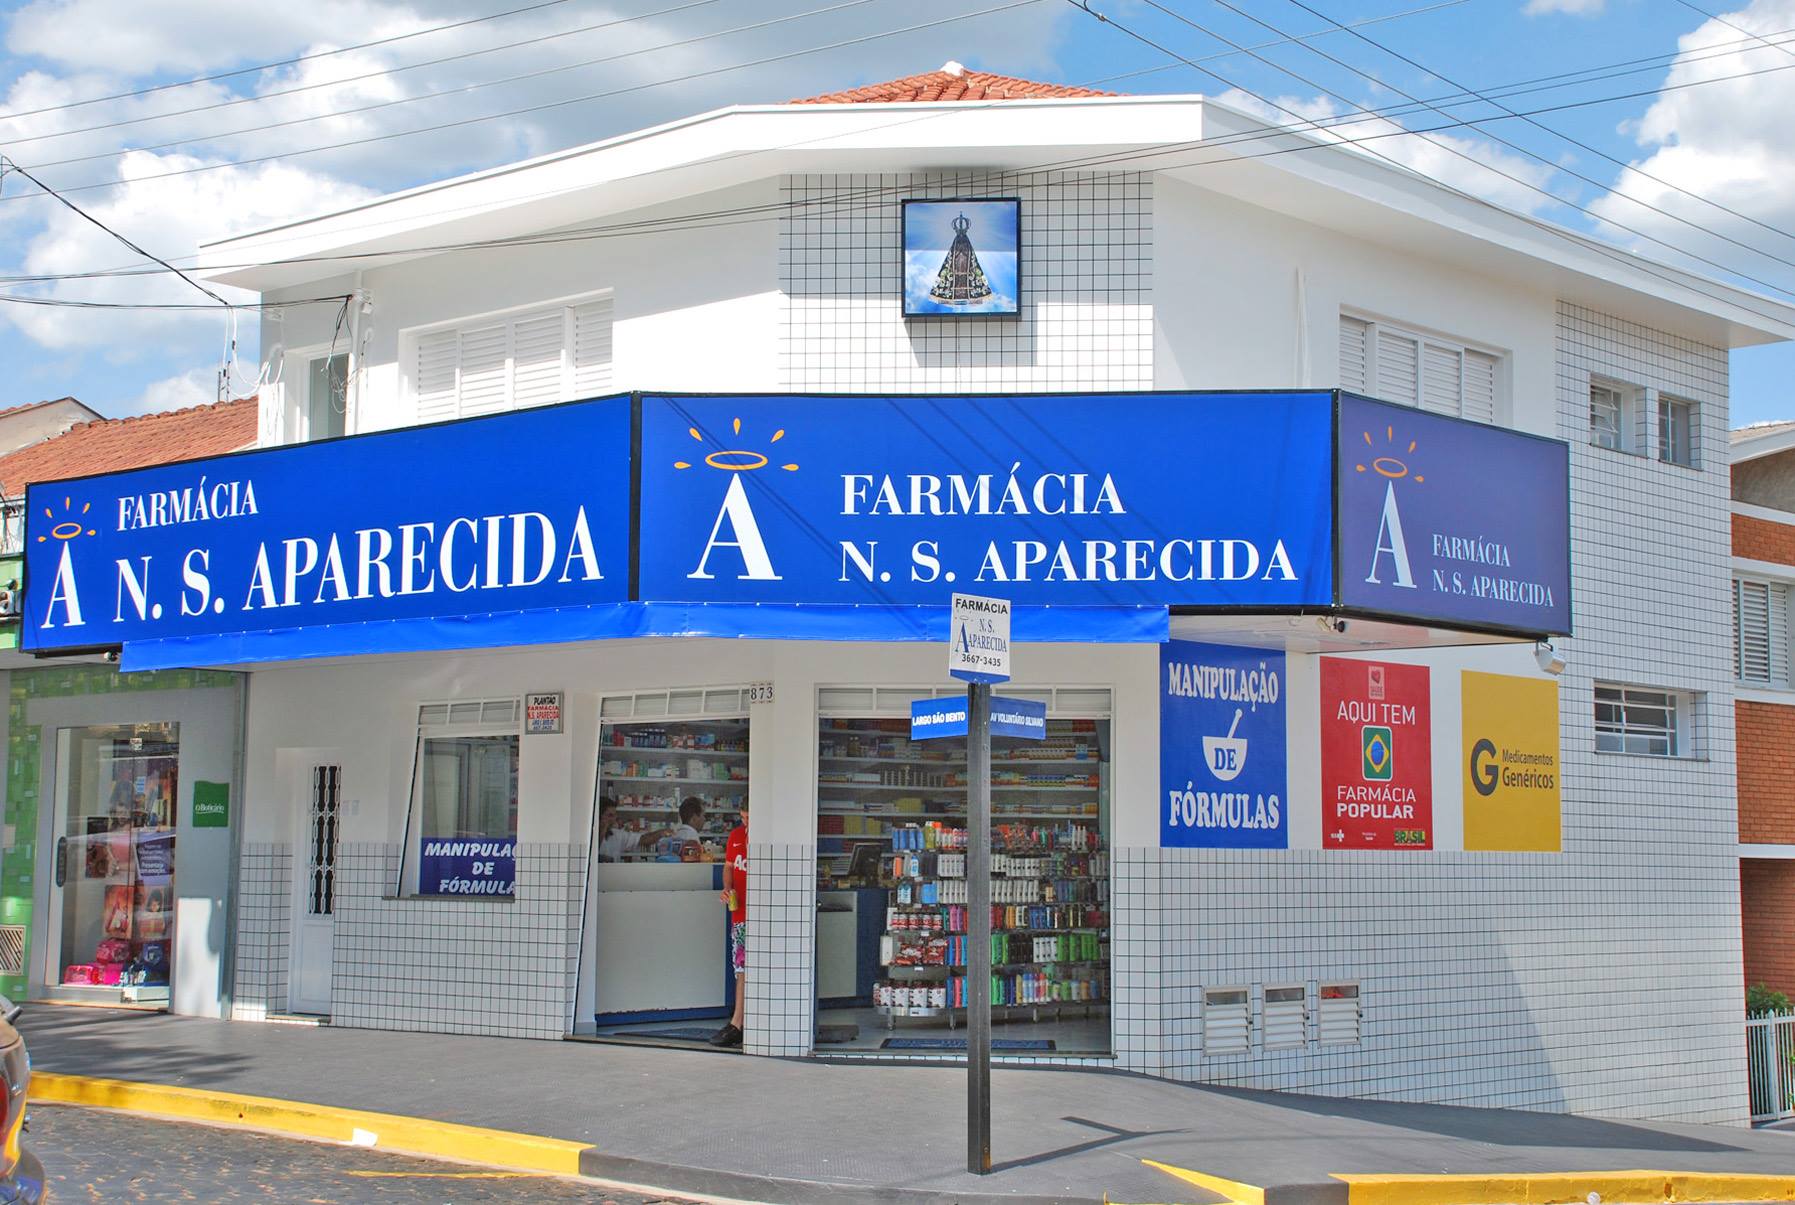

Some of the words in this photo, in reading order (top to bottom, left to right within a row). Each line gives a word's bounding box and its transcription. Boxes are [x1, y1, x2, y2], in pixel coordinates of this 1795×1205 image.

[116, 477, 259, 531] FARMÁCIA
[840, 462, 1127, 515] FARMÁCIA
[687, 473, 782, 581] A
[1365, 480, 1417, 589] A
[114, 556, 162, 623] N.
[181, 549, 224, 617] S.
[242, 505, 604, 611] APARECIDA
[839, 541, 891, 582] N.
[911, 540, 956, 582] S.
[975, 539, 1299, 582] APARECIDA
[1432, 534, 1511, 567] FARMÁCIA
[41, 541, 85, 629] A
[1432, 569, 1449, 593] N.
[1453, 572, 1466, 595] S.
[1471, 576, 1554, 607] APARECIDA
[955, 598, 1008, 615] FARMÁCIA
[751, 687, 773, 700] 873
[1168, 661, 1279, 712] MANIPULAÇÃO
[1337, 701, 1376, 723] AQUI
[1381, 703, 1416, 725] TEM
[1214, 747, 1237, 771] DE
[1471, 738, 1499, 796] G
[1502, 749, 1553, 766] Medicamentos
[1337, 785, 1416, 802] FARMÁCIA
[1502, 767, 1554, 789] Genéricos
[1169, 781, 1280, 829] FÓRMULAS
[1337, 803, 1414, 819] POPULAR
[1394, 829, 1425, 843] BRASIL
[472, 861, 495, 875] DE
